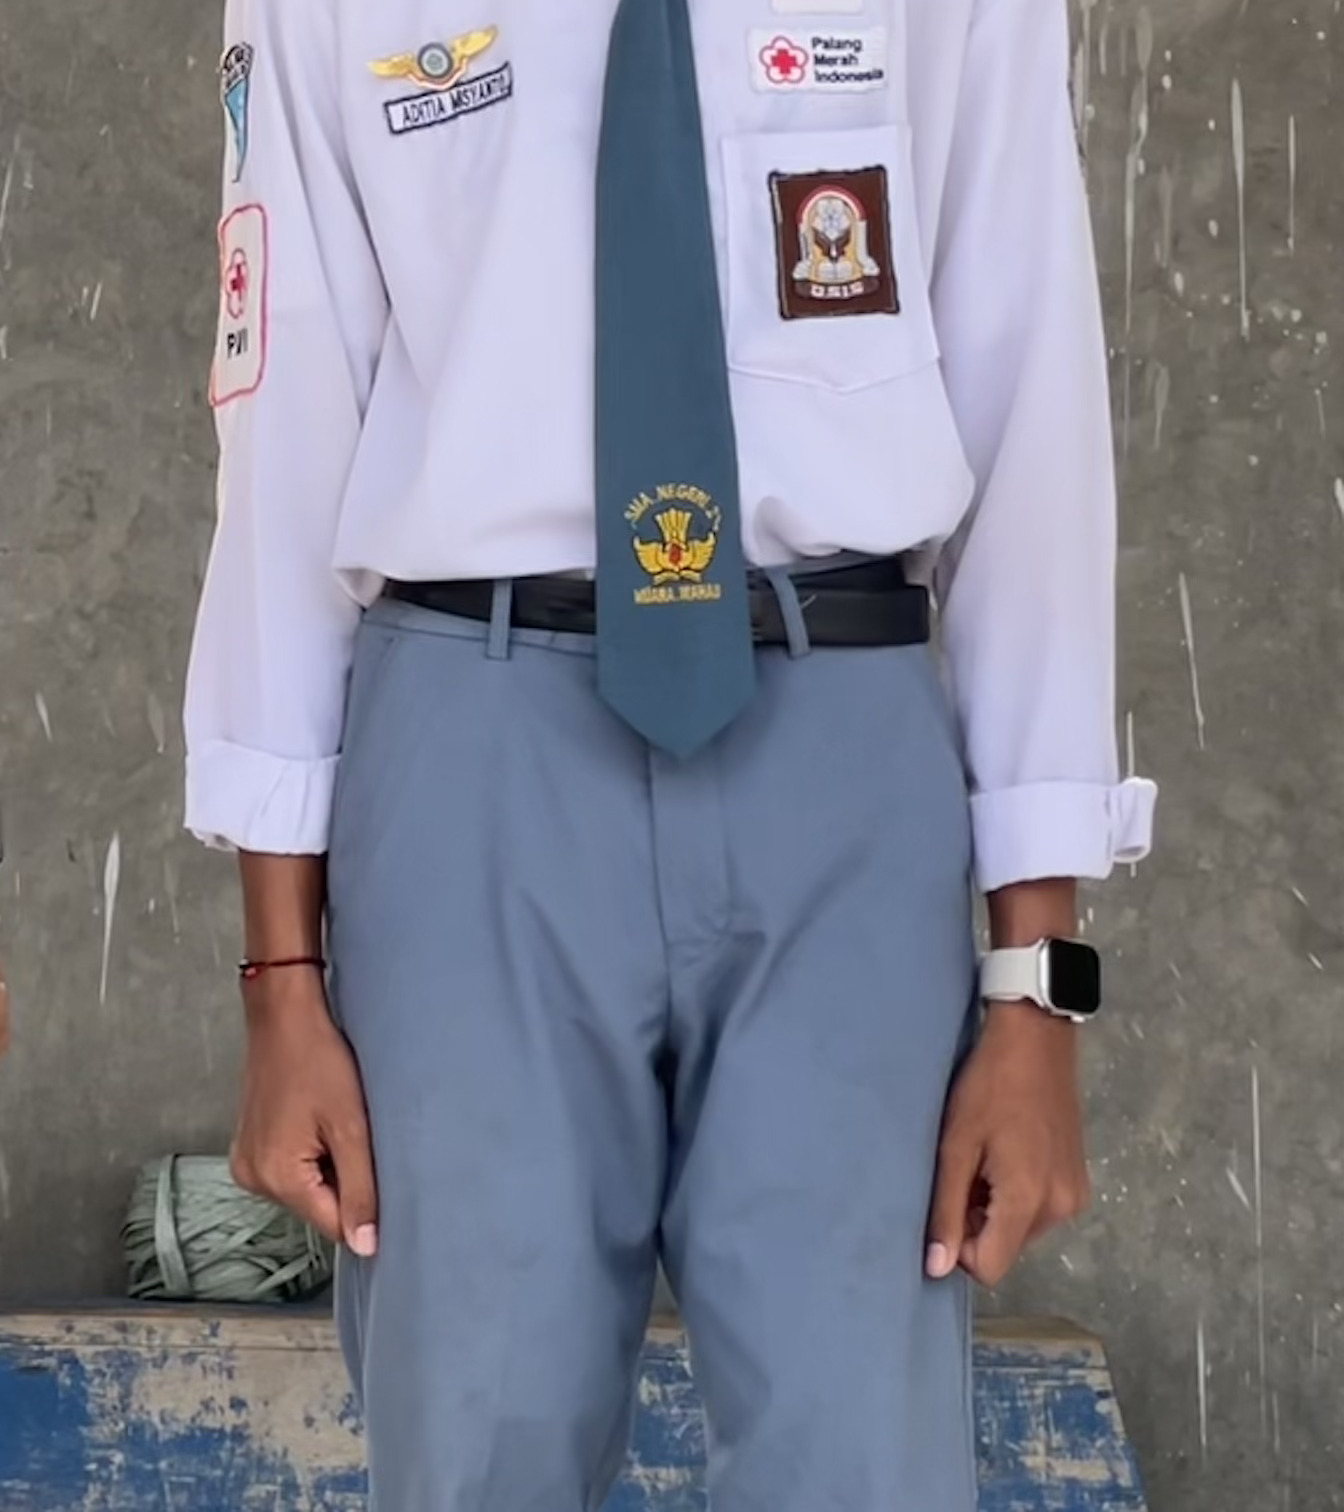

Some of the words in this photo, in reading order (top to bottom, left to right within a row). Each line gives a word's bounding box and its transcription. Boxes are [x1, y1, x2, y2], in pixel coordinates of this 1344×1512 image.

[812, 36, 863, 53] Palang
[813, 53, 859, 66] Merah
[814, 68, 884, 83] Indonesia
[403, 95, 446, 126] ADITIA
[810, 280, 865, 299] OSIS
